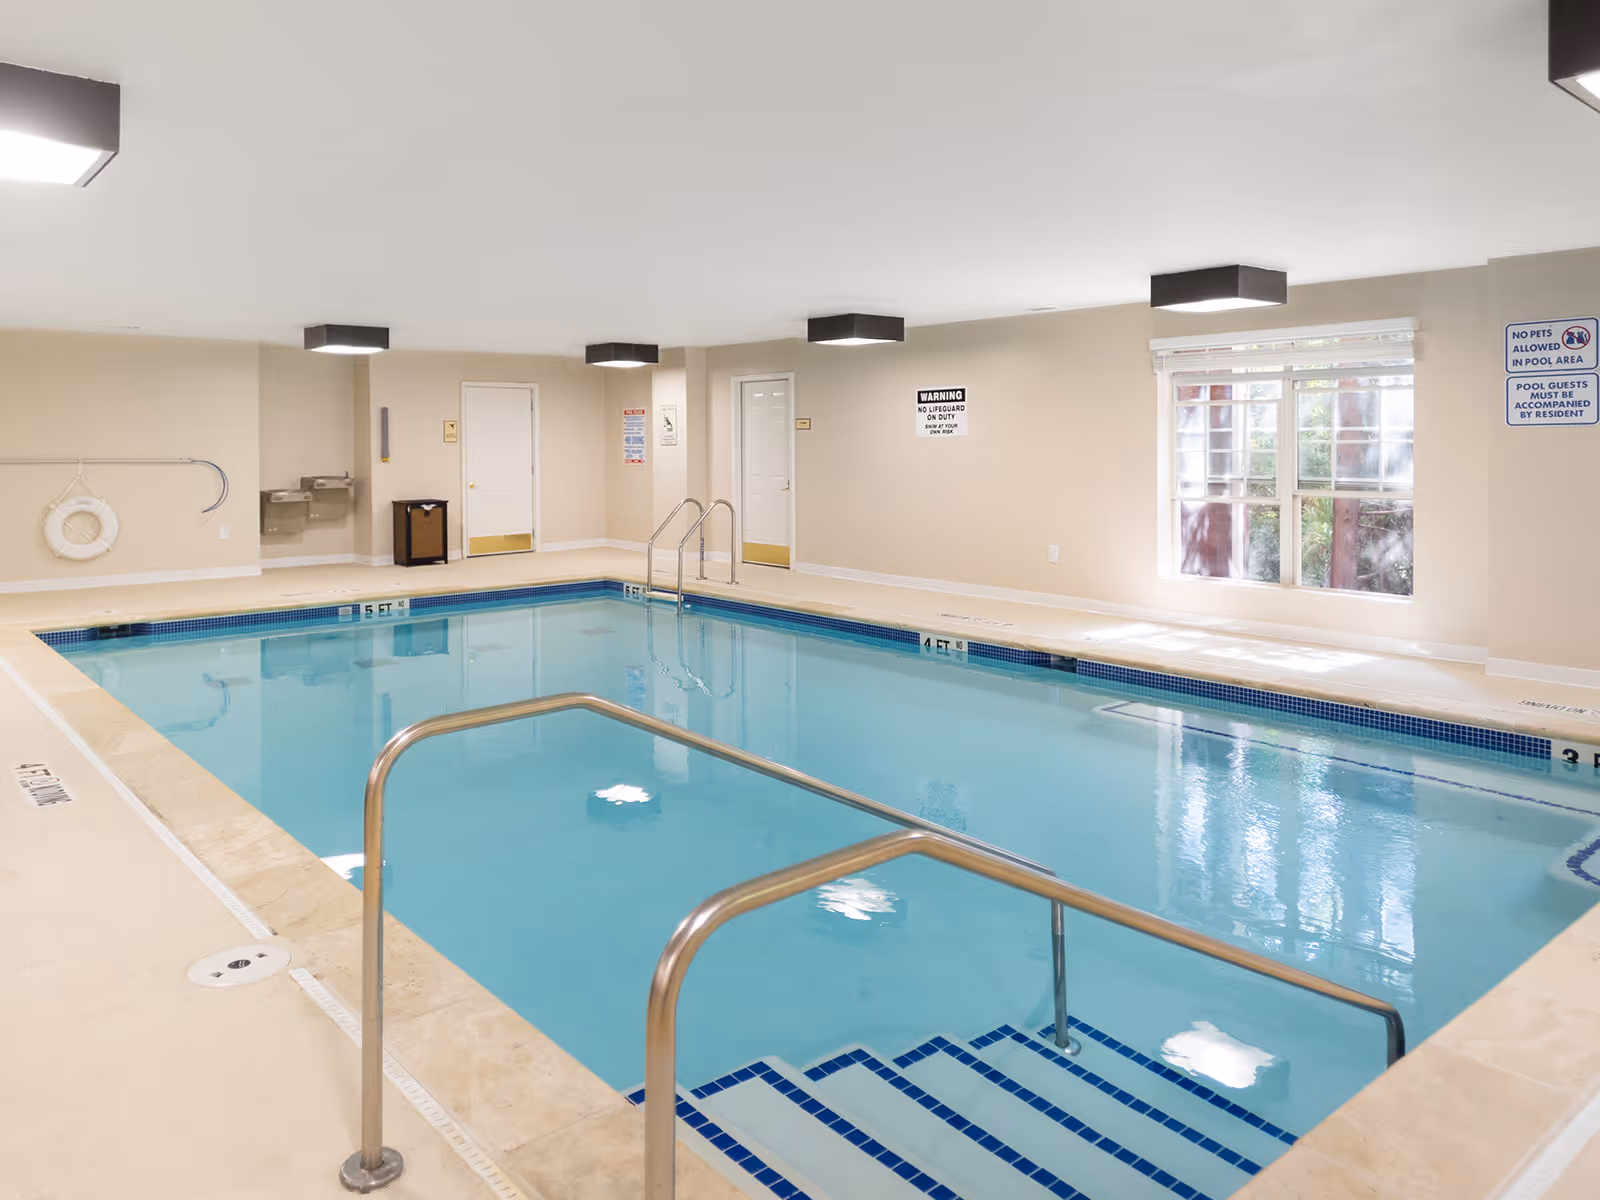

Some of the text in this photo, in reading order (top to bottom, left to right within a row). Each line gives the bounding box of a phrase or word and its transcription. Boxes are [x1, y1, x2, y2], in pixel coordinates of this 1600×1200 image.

[1512, 329, 1552, 339] NO PETS
[1513, 343, 1560, 353] ALLOWED
[1512, 355, 1584, 367] IN POOL AREA
[1516, 381, 1588, 391] POOL GUESTS
[920, 391, 963, 402] WARNING
[1530, 391, 1574, 400] MUST BE
[929, 405, 965, 413] LIFEGUARD
[1514, 400, 1591, 409] ACCOMPANIED
[1535, 410, 1584, 418] RESIDENT
[364, 605, 373, 614] 5
[378, 603, 392, 613] FT
[924, 638, 931, 647] 4
[936, 639, 950, 650] FT
[1562, 748, 1579, 764] 3
